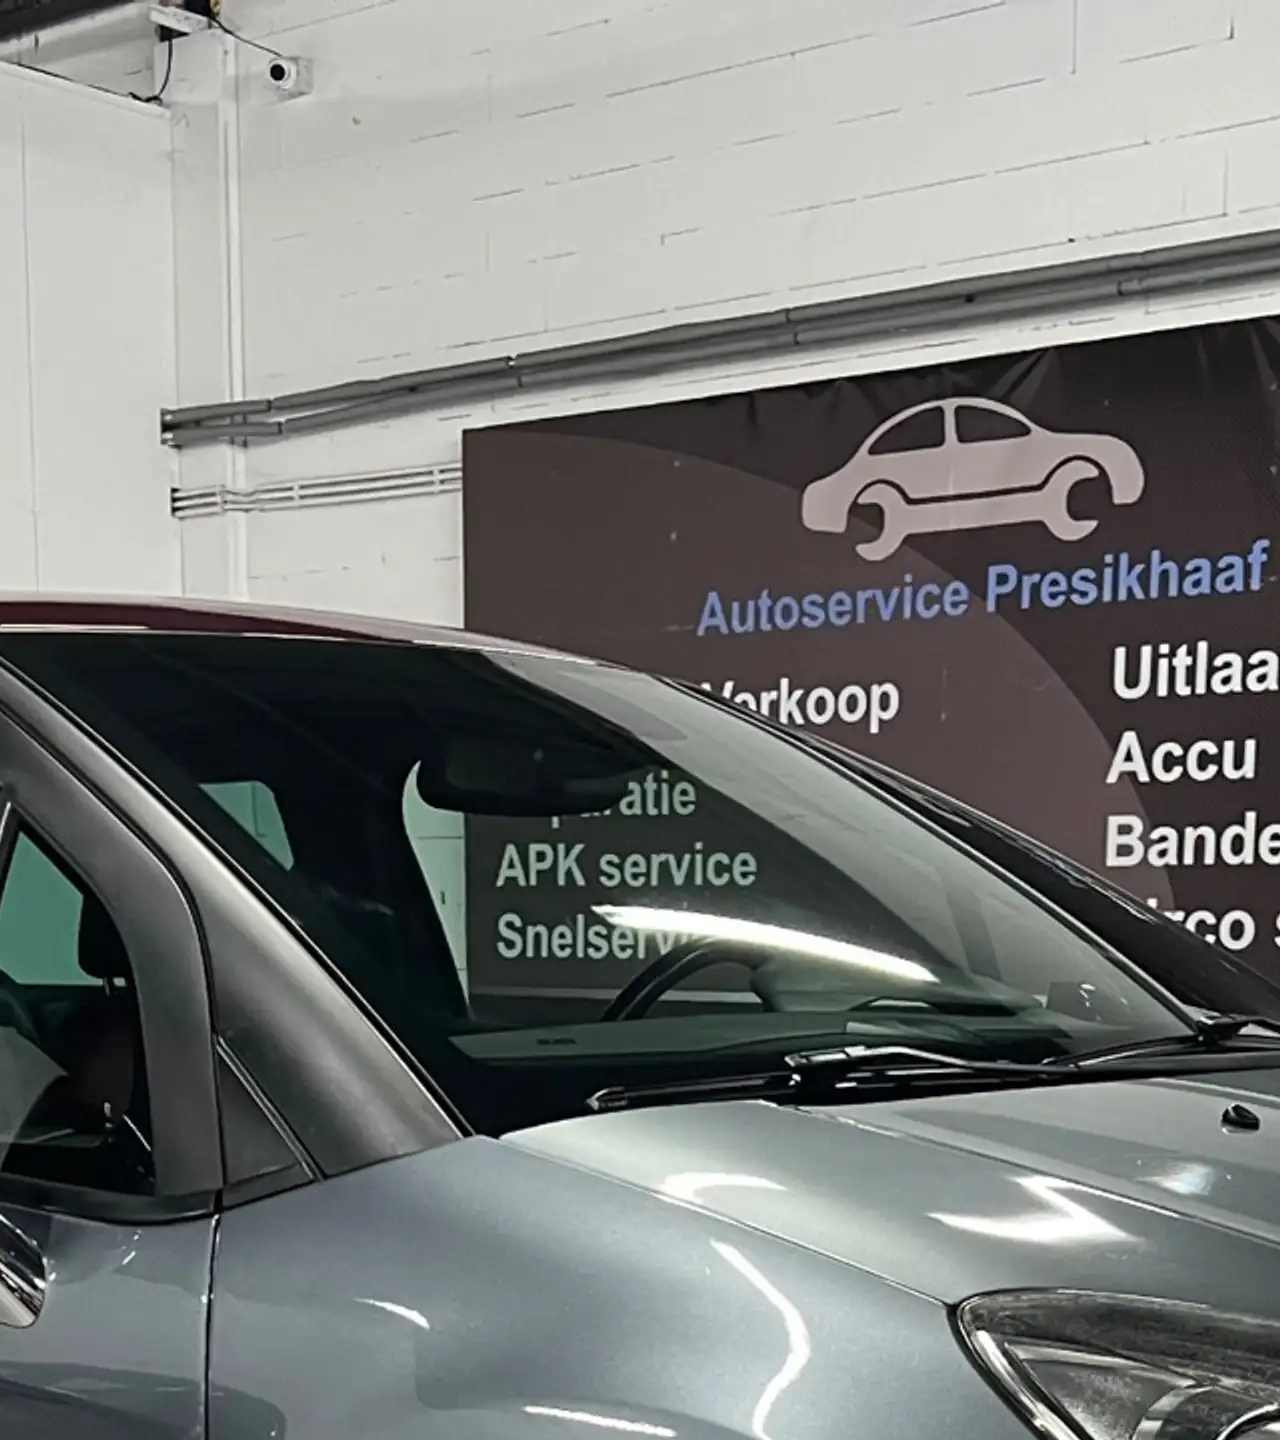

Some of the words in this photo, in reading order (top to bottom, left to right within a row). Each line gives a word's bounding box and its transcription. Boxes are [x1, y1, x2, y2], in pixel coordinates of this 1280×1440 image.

[696, 573, 969, 637] Autoservice
[985, 539, 1270, 613] Presikhaaf
[1105, 730, 1257, 784] Accu
[496, 843, 587, 887] APK
[599, 842, 757, 887] service
